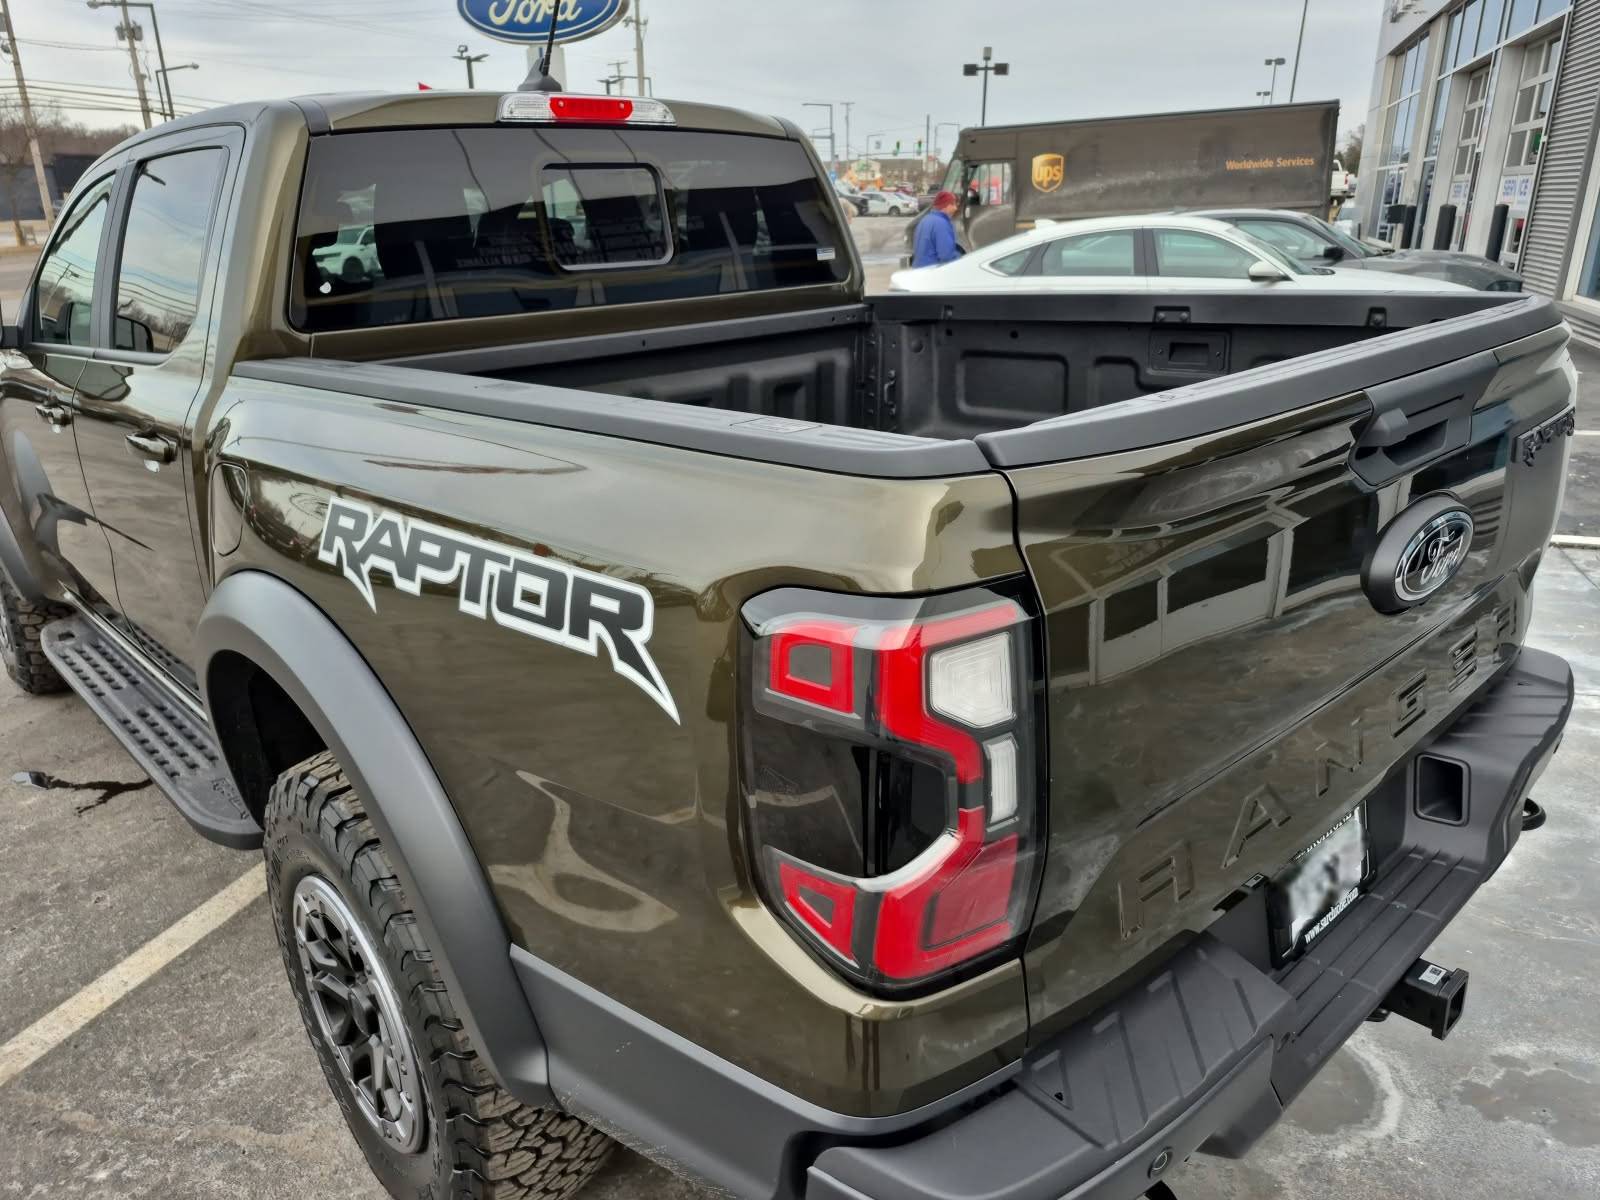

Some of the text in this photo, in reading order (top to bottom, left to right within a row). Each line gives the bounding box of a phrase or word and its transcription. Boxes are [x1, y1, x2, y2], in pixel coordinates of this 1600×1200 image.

[1034, 166, 1062, 187] ups
[1225, 156, 1315, 171] Worldwide Services
[1420, 530, 1465, 586] Ford
[318, 496, 681, 726] RAPTOR
[1117, 598, 1519, 944] RANGER
